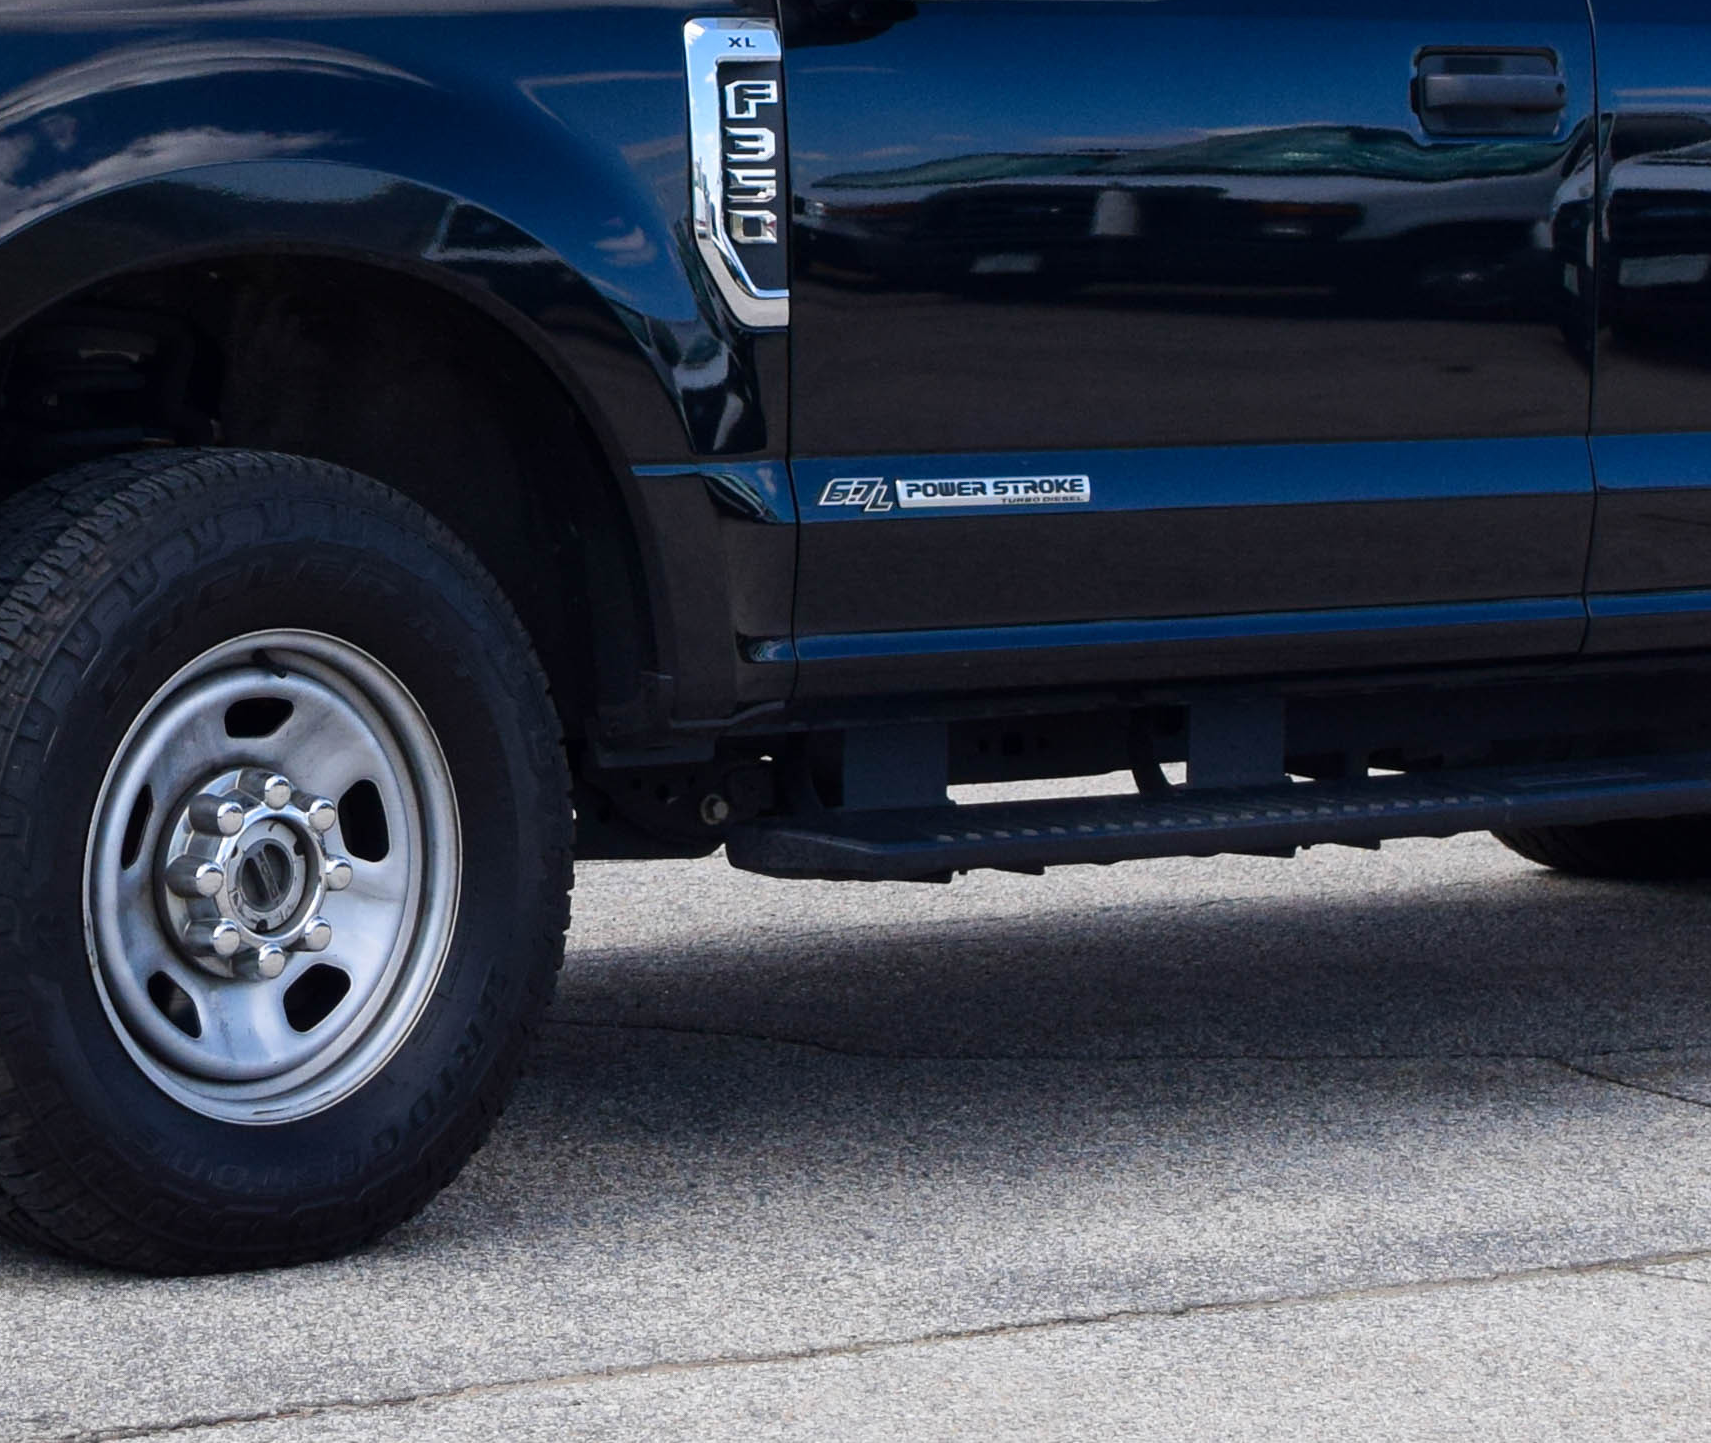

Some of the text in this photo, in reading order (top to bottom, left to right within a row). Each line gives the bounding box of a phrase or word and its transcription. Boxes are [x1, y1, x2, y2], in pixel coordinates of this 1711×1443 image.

[728, 36, 756, 48] XL
[724, 80, 778, 245] F350
[906, 477, 1085, 499] POWER STROKE
[1001, 495, 1085, 505] TURBO DIESEL
